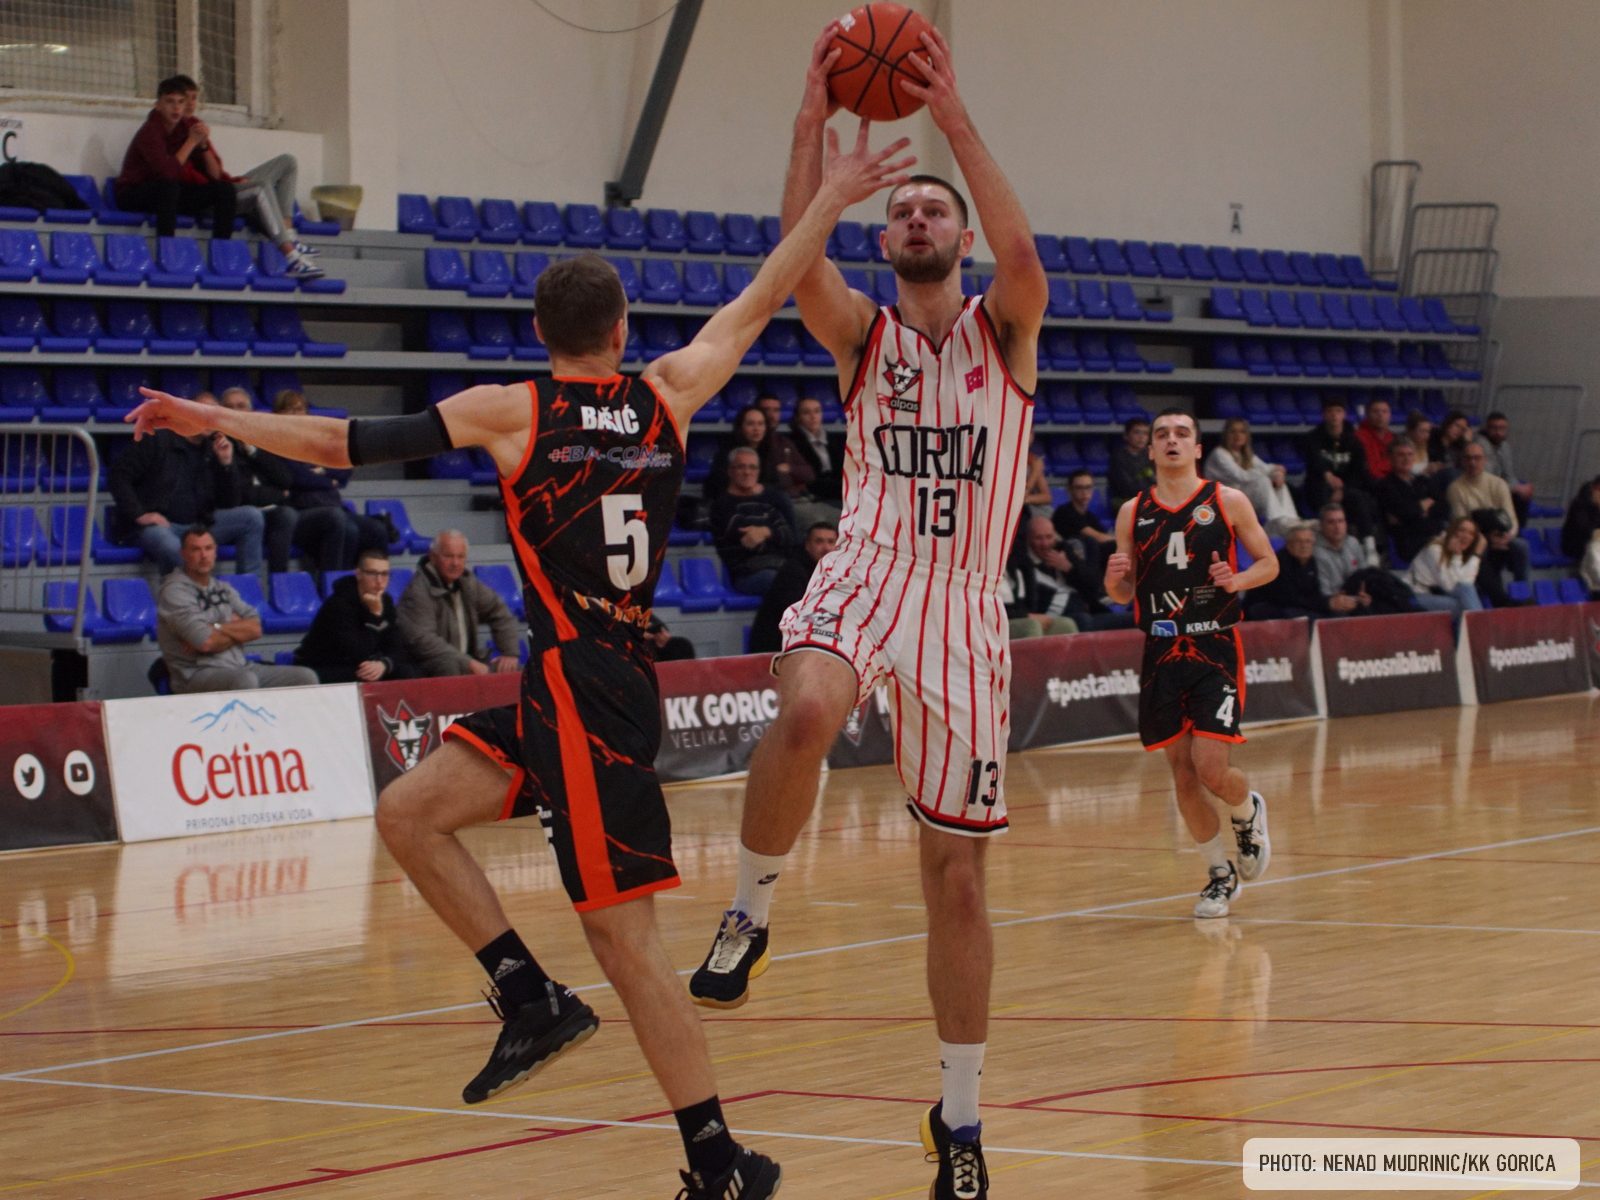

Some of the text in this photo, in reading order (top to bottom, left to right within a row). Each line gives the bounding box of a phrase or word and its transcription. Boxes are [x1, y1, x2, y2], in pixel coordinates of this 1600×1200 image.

[890, 399, 919, 411] alpas
[873, 422, 988, 487] GORICA
[918, 487, 956, 537] 13
[601, 493, 649, 591] 5
[1166, 531, 1189, 570] 4
[1186, 620, 1220, 633] KRKA
[664, 689, 779, 730] KK GORIC
[1215, 695, 1235, 728] 4
[670, 728, 728, 749] VELIKA
[172, 742, 309, 806] Cetina
[968, 759, 998, 806] 13
[287, 808, 313, 820] VODA
